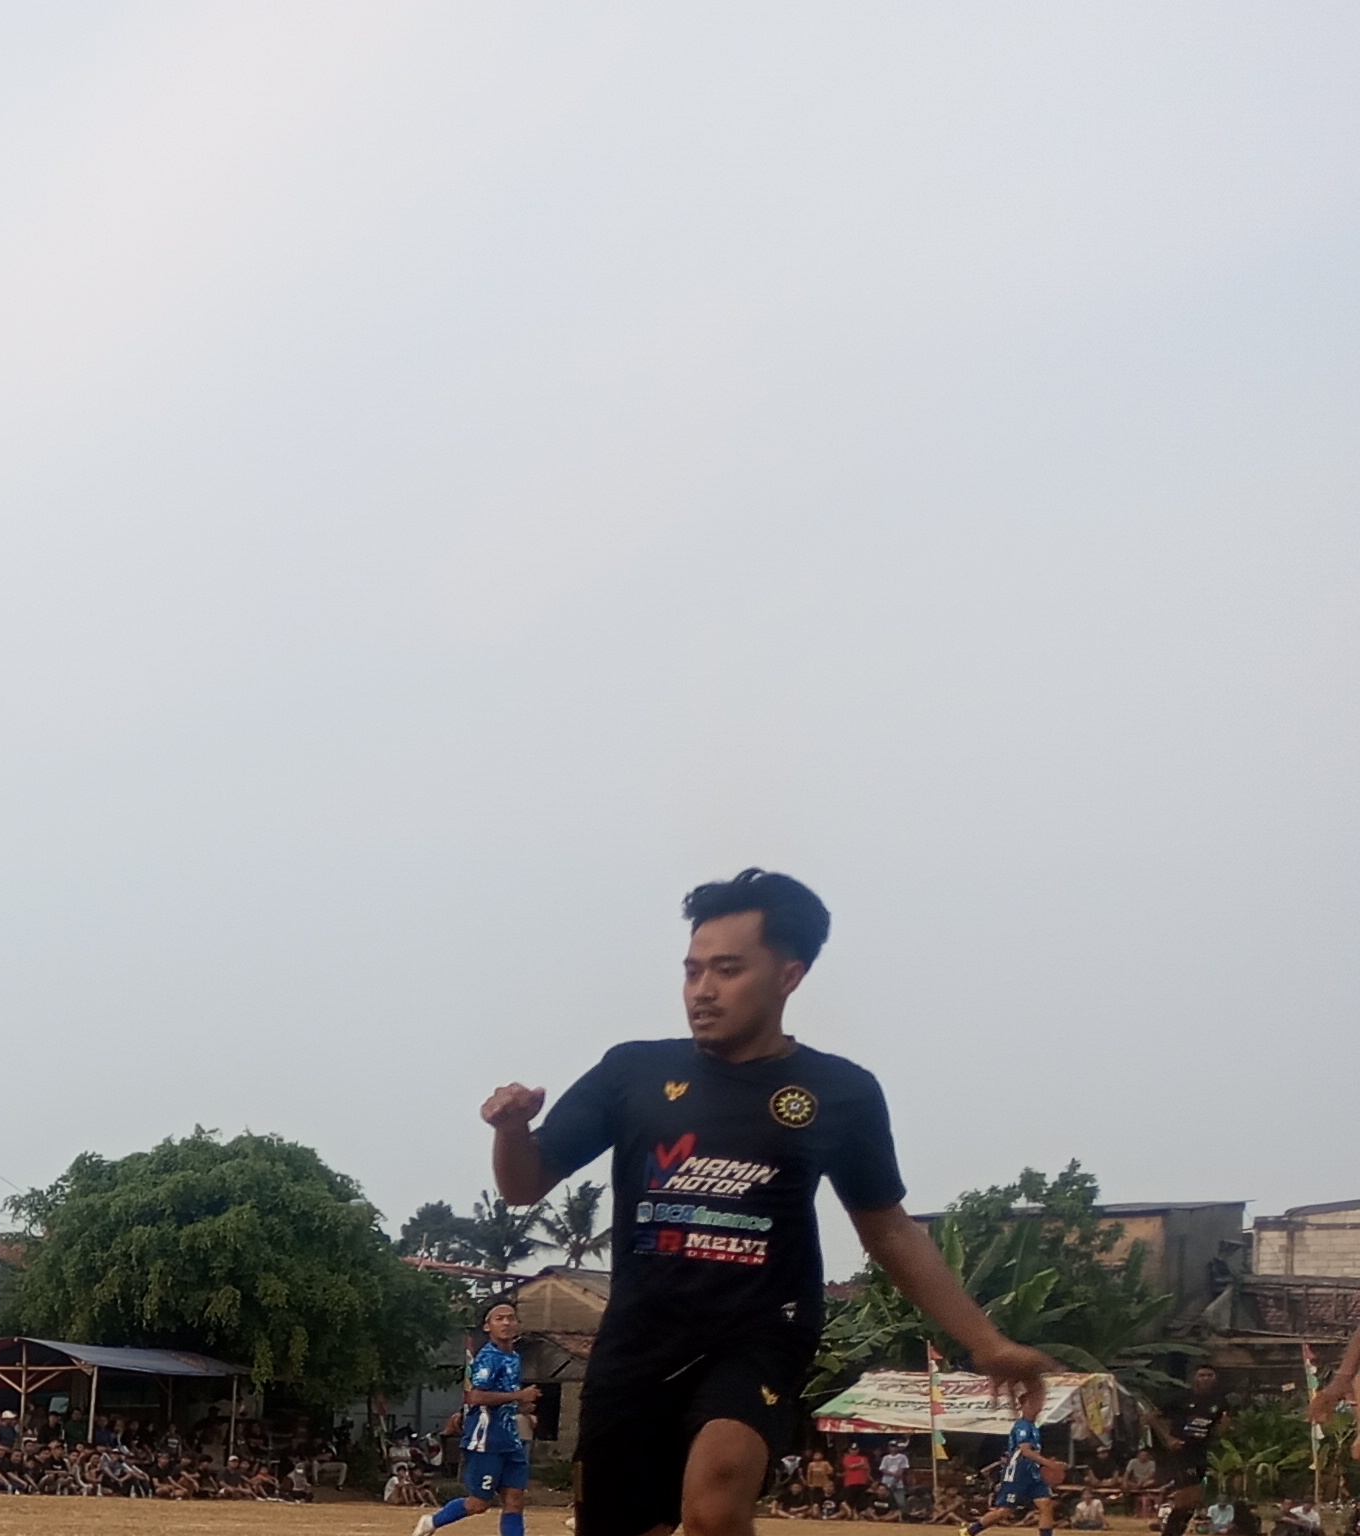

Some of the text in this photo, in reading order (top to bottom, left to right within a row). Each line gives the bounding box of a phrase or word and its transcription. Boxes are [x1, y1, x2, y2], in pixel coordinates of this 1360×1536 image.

[677, 1156, 780, 1184] MAMIN
[662, 1176, 751, 1195] MOTOR
[481, 1474, 493, 1490] 2
